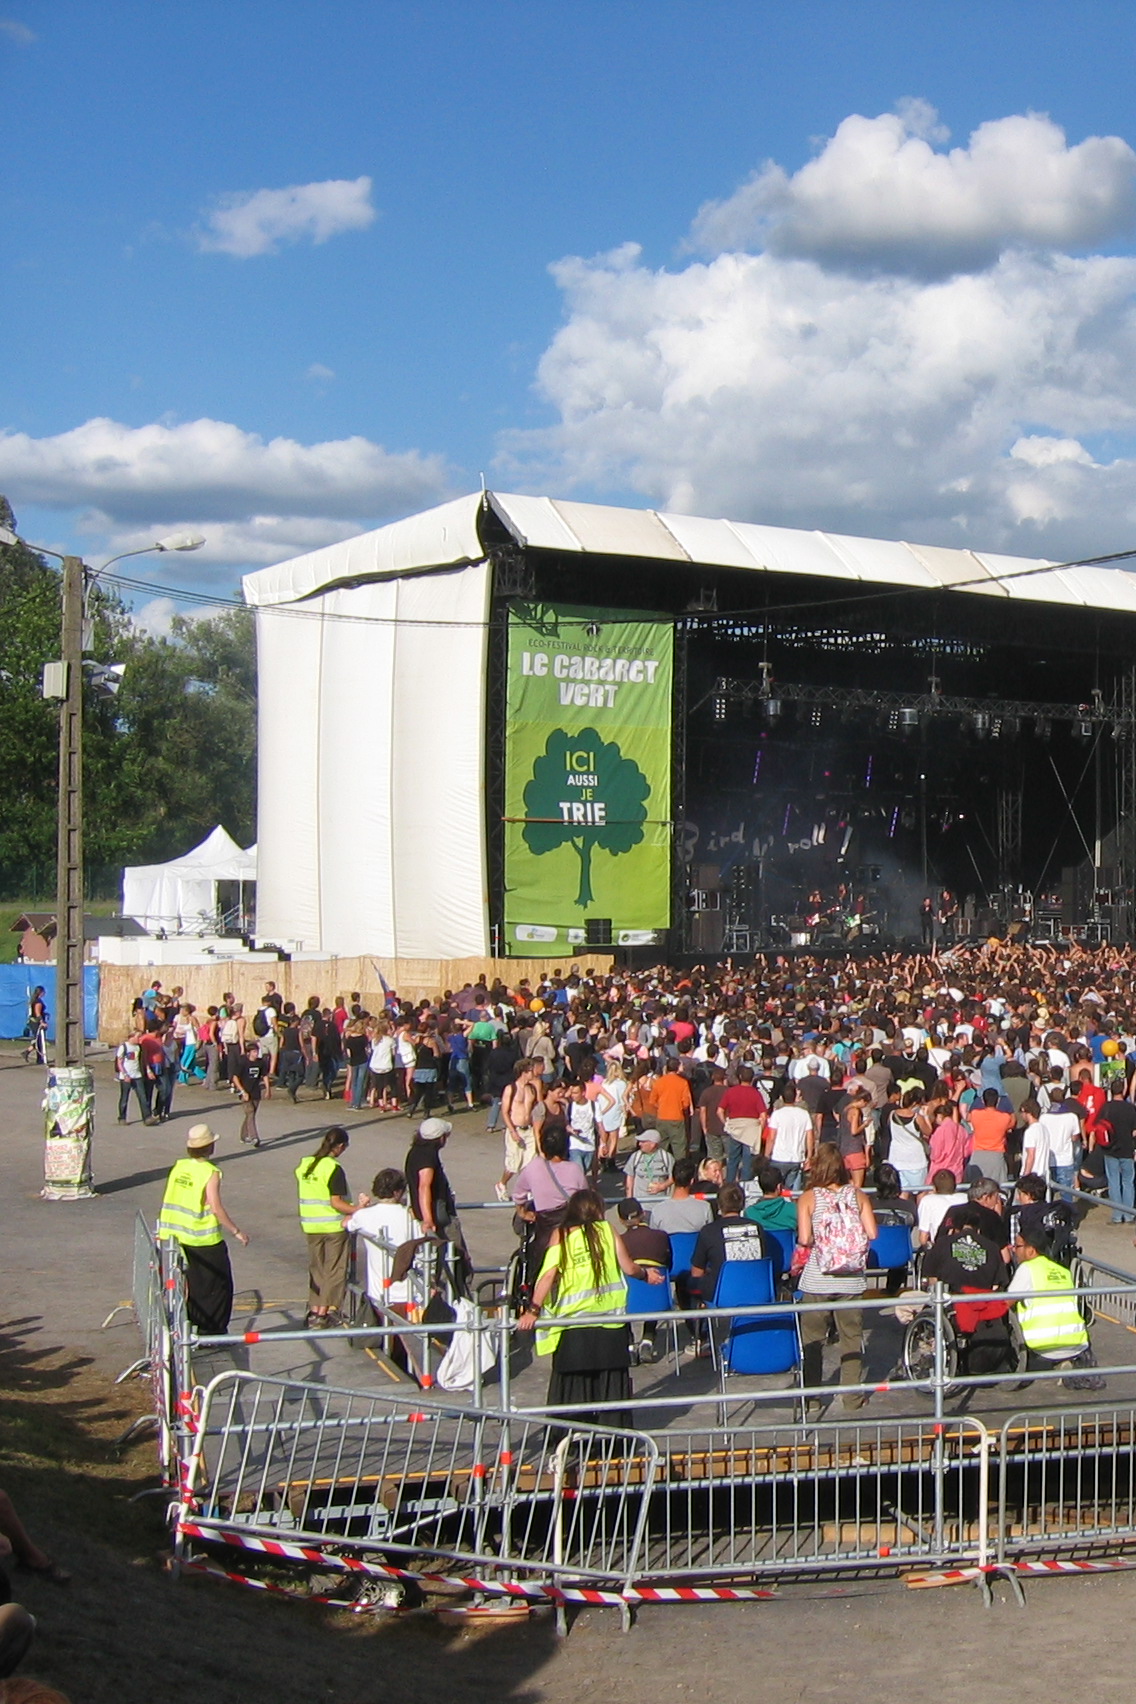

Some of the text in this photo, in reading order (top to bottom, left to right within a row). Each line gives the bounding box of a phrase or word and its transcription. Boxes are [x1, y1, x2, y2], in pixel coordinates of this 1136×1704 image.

[565, 750, 595, 772] ICI
[566, 774, 598, 787] AUSSI
[580, 788, 594, 801] JE
[559, 801, 606, 826] TRIE
